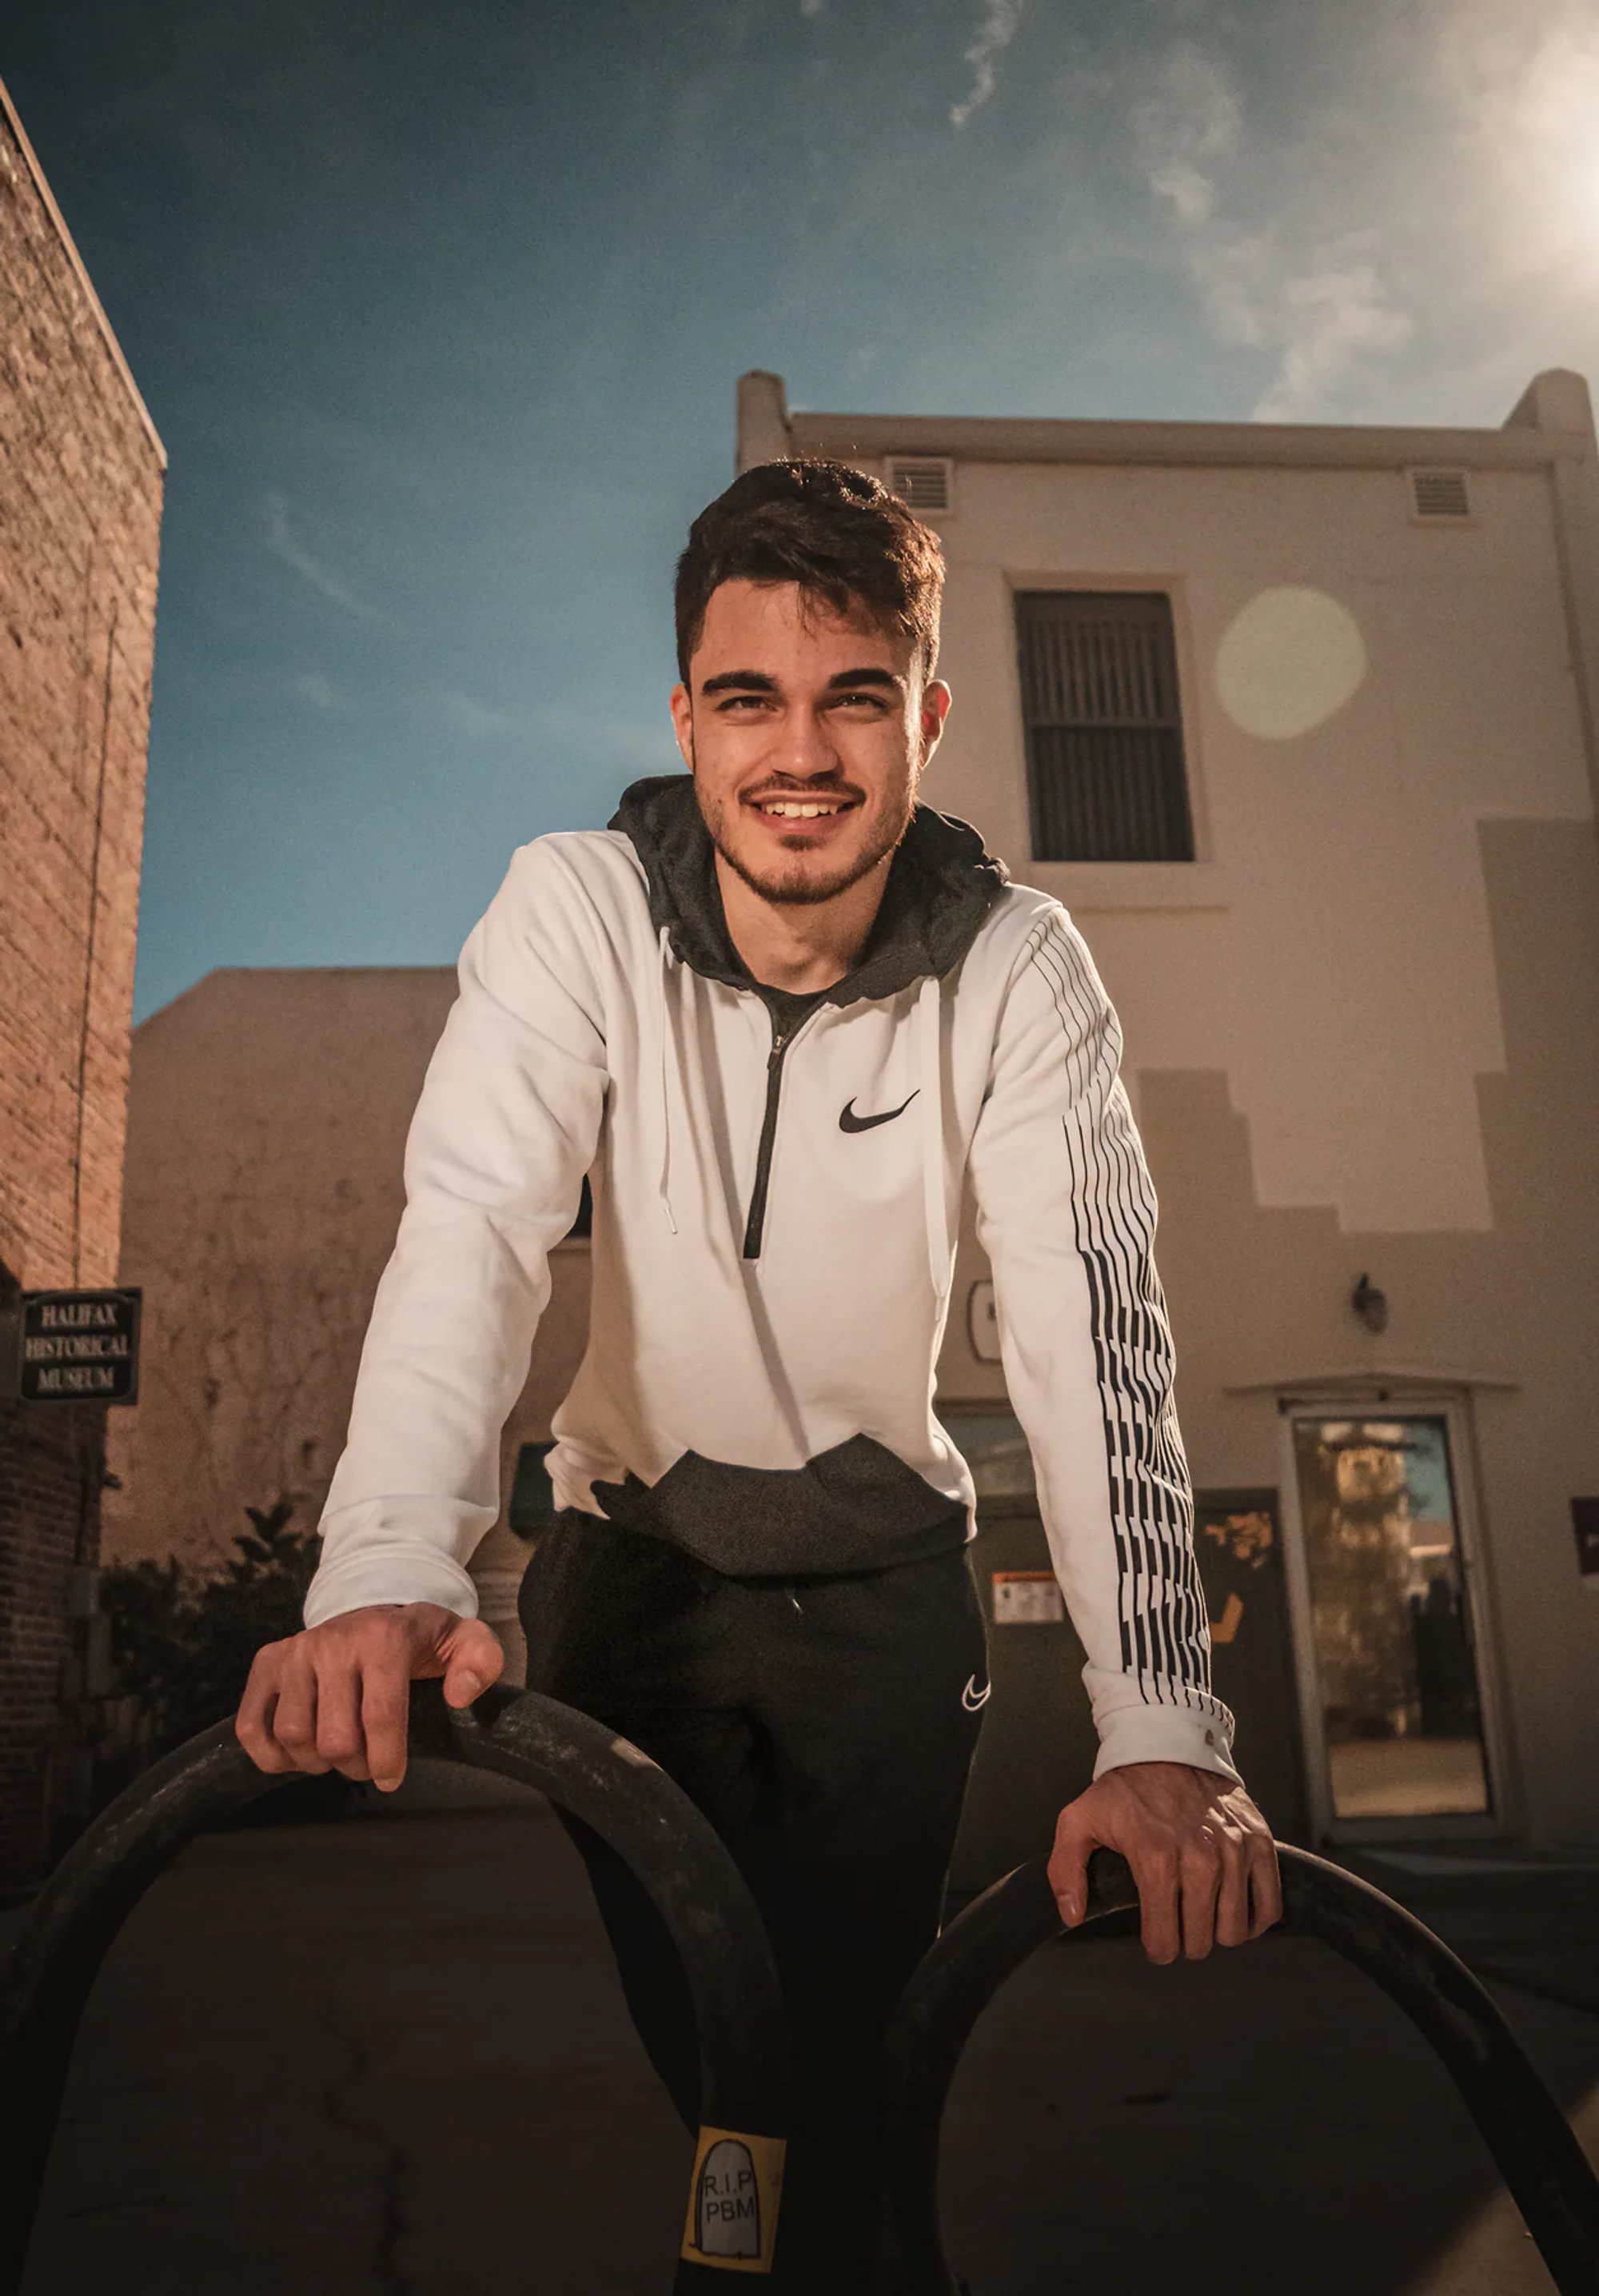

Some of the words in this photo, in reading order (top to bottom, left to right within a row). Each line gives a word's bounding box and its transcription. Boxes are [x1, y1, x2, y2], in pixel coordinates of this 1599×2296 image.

[41, 1303, 118, 1328] HALIFAX
[25, 1334, 128, 1359] HISTORICAL
[37, 1366, 114, 1392] MUSEUM
[706, 2197, 755, 2223] PBM
